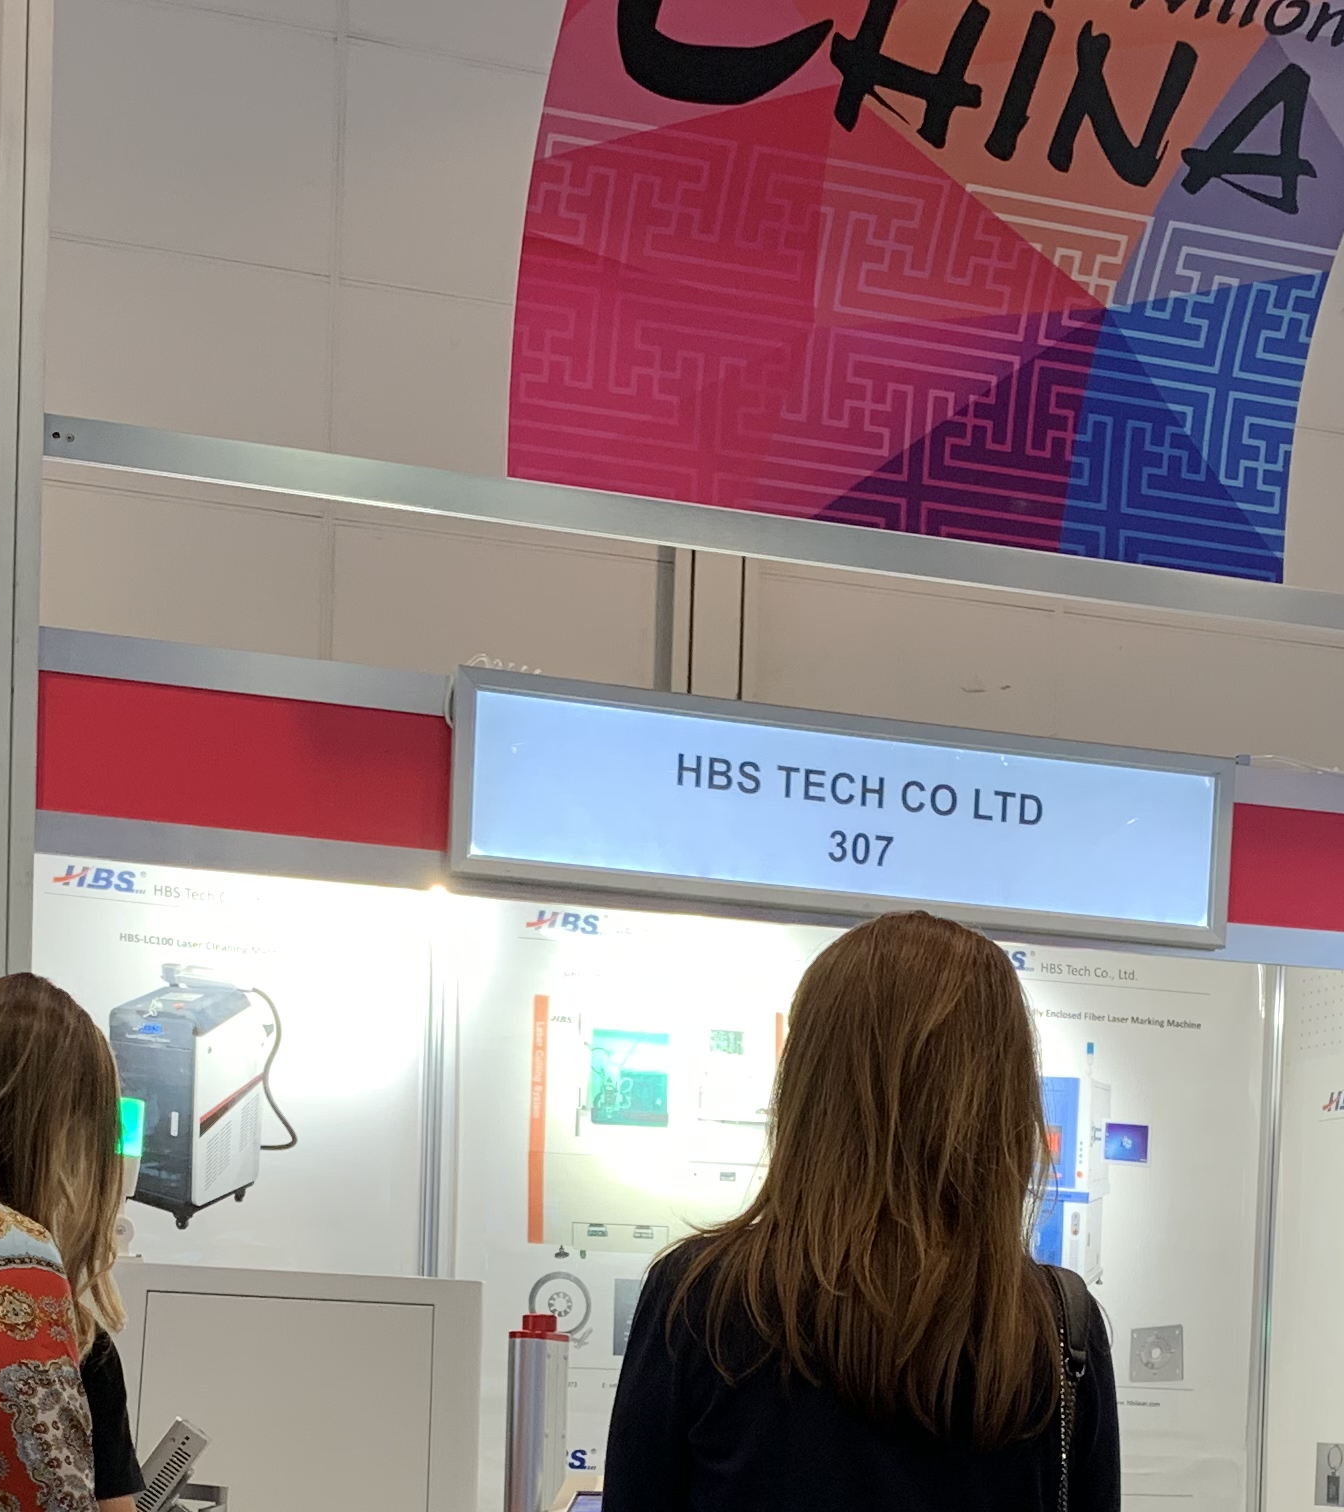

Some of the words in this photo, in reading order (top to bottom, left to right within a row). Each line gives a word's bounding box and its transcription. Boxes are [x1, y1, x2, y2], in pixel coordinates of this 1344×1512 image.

[676, 753, 760, 796] HBS
[776, 765, 885, 810] TECH
[900, 780, 958, 817] CO
[973, 788, 1043, 827] LTD
[827, 831, 893, 867] 307
[53, 865, 136, 894] HBS
[154, 884, 180, 899] HBS
[526, 910, 600, 935] HBS
[119, 932, 174, 946] HBS-LC100
[176, 938, 202, 949] Laser
[1040, 963, 1063, 975] HBS
[1065, 965, 1090, 978] Tech
[1118, 969, 1138, 981] Ltd.
[1046, 1009, 1082, 1020] Enclosed
[1084, 1012, 1105, 1022] Fiber
[1107, 1014, 1129, 1024] Laser
[1131, 1016, 1164, 1028] Marking
[1167, 1019, 1202, 1030] Machine
